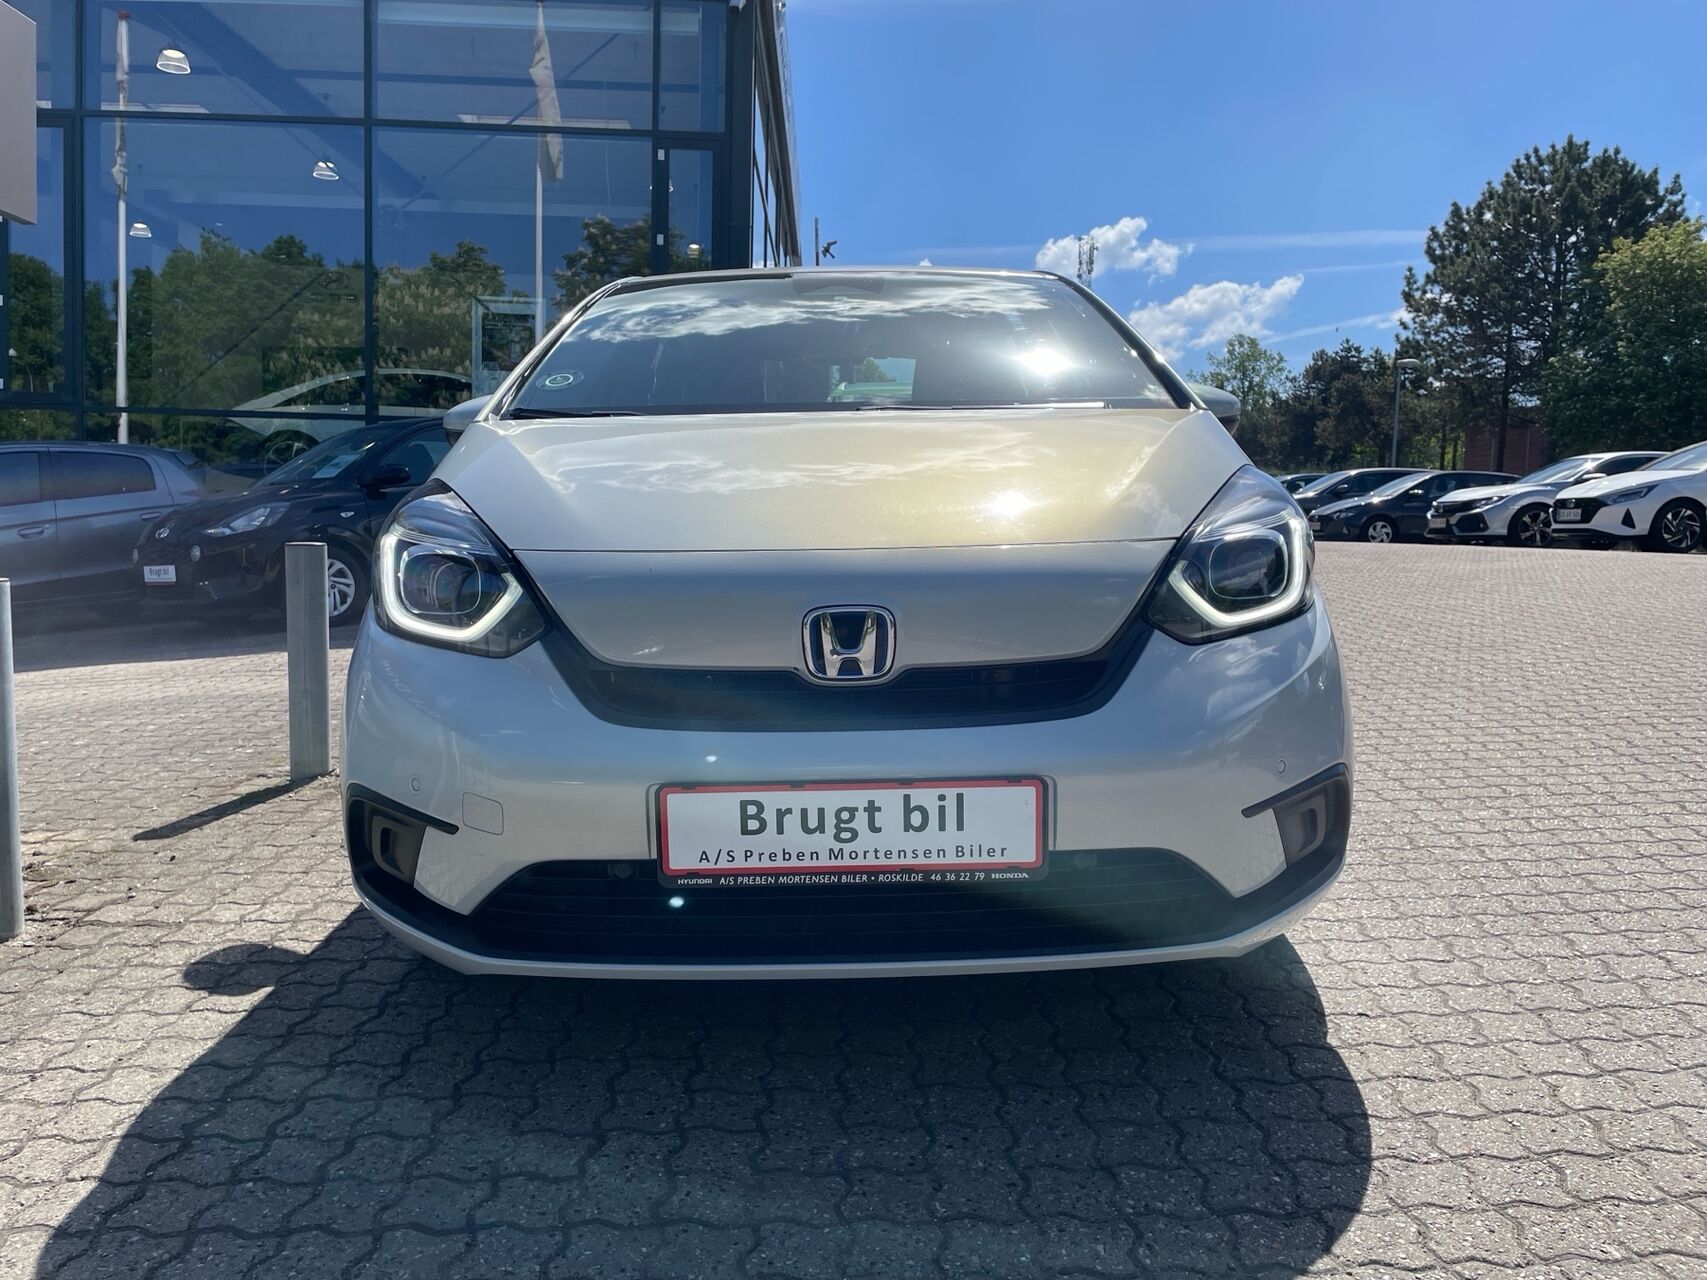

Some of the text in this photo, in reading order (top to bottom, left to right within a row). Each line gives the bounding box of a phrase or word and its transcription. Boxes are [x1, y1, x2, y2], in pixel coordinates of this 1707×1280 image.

[739, 792, 965, 844] Brugt bil
[698, 844, 1008, 865] A/S Preben Mortensen Biler
[719, 876, 735, 885] A/S
[737, 876, 775, 885] PREBEN
[778, 875, 839, 884] MORTENSEN
[841, 874, 868, 883] BILER
[878, 873, 924, 882] ROSKILDE
[930, 872, 942, 881] 46
[945, 872, 956, 881] 36
[959, 872, 970, 881] 22
[974, 872, 985, 881] 79
[991, 872, 1030, 880] HONDA
